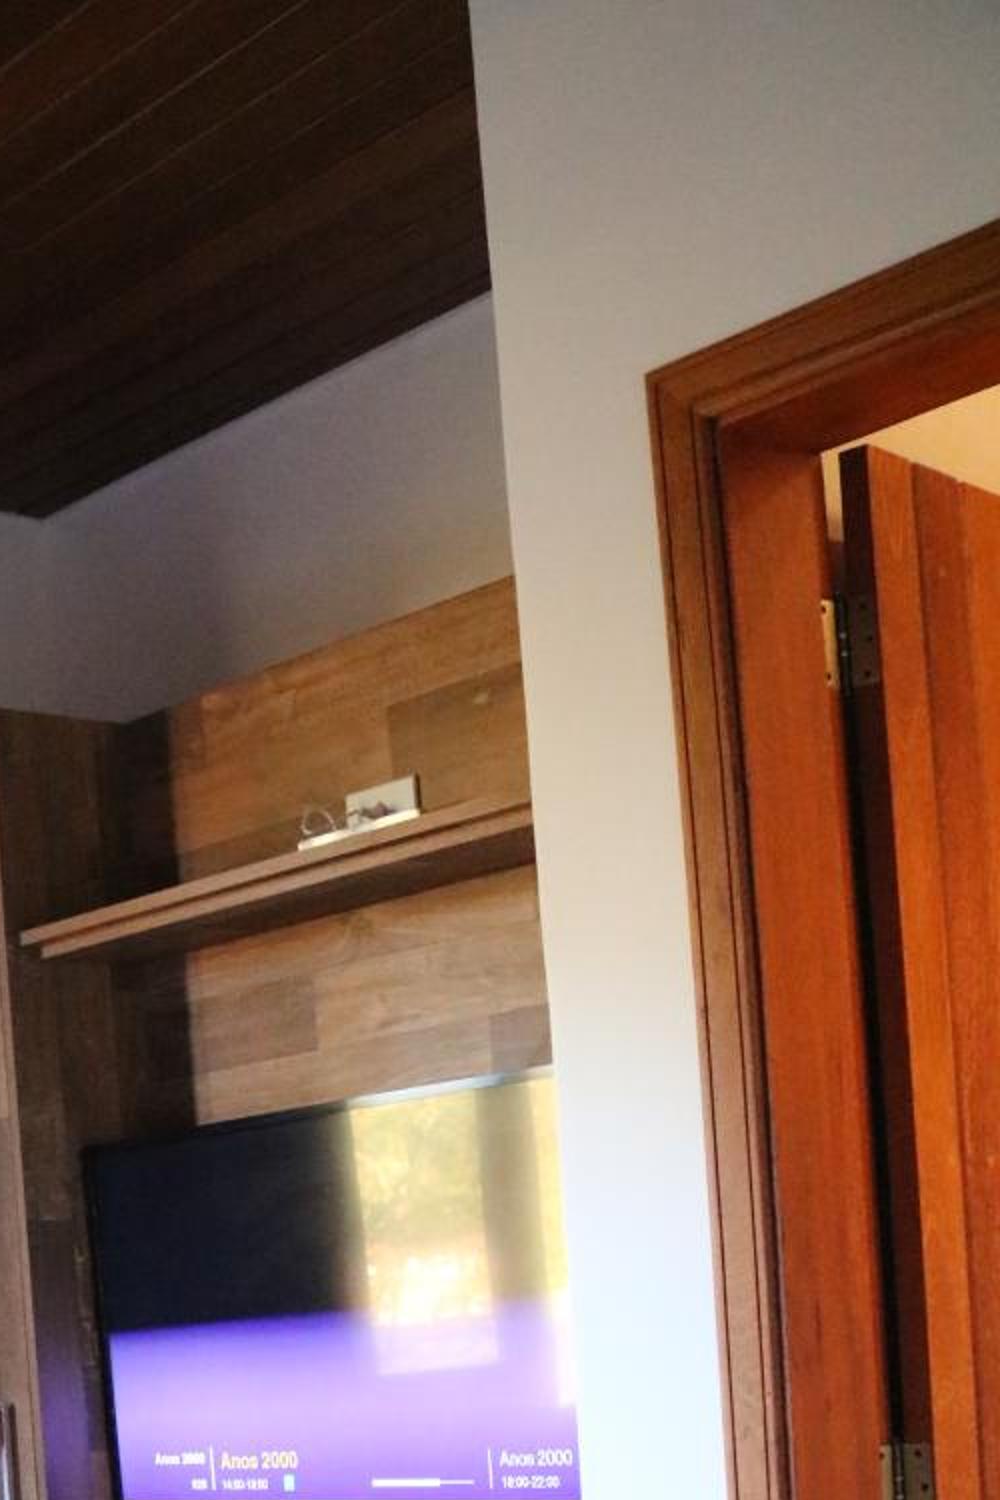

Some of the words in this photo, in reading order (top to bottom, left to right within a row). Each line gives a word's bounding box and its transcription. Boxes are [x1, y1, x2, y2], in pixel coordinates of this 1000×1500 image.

[221, 1452, 258, 1469] Anos
[261, 1451, 298, 1469] 2000
[537, 1449, 573, 1467] 2000
